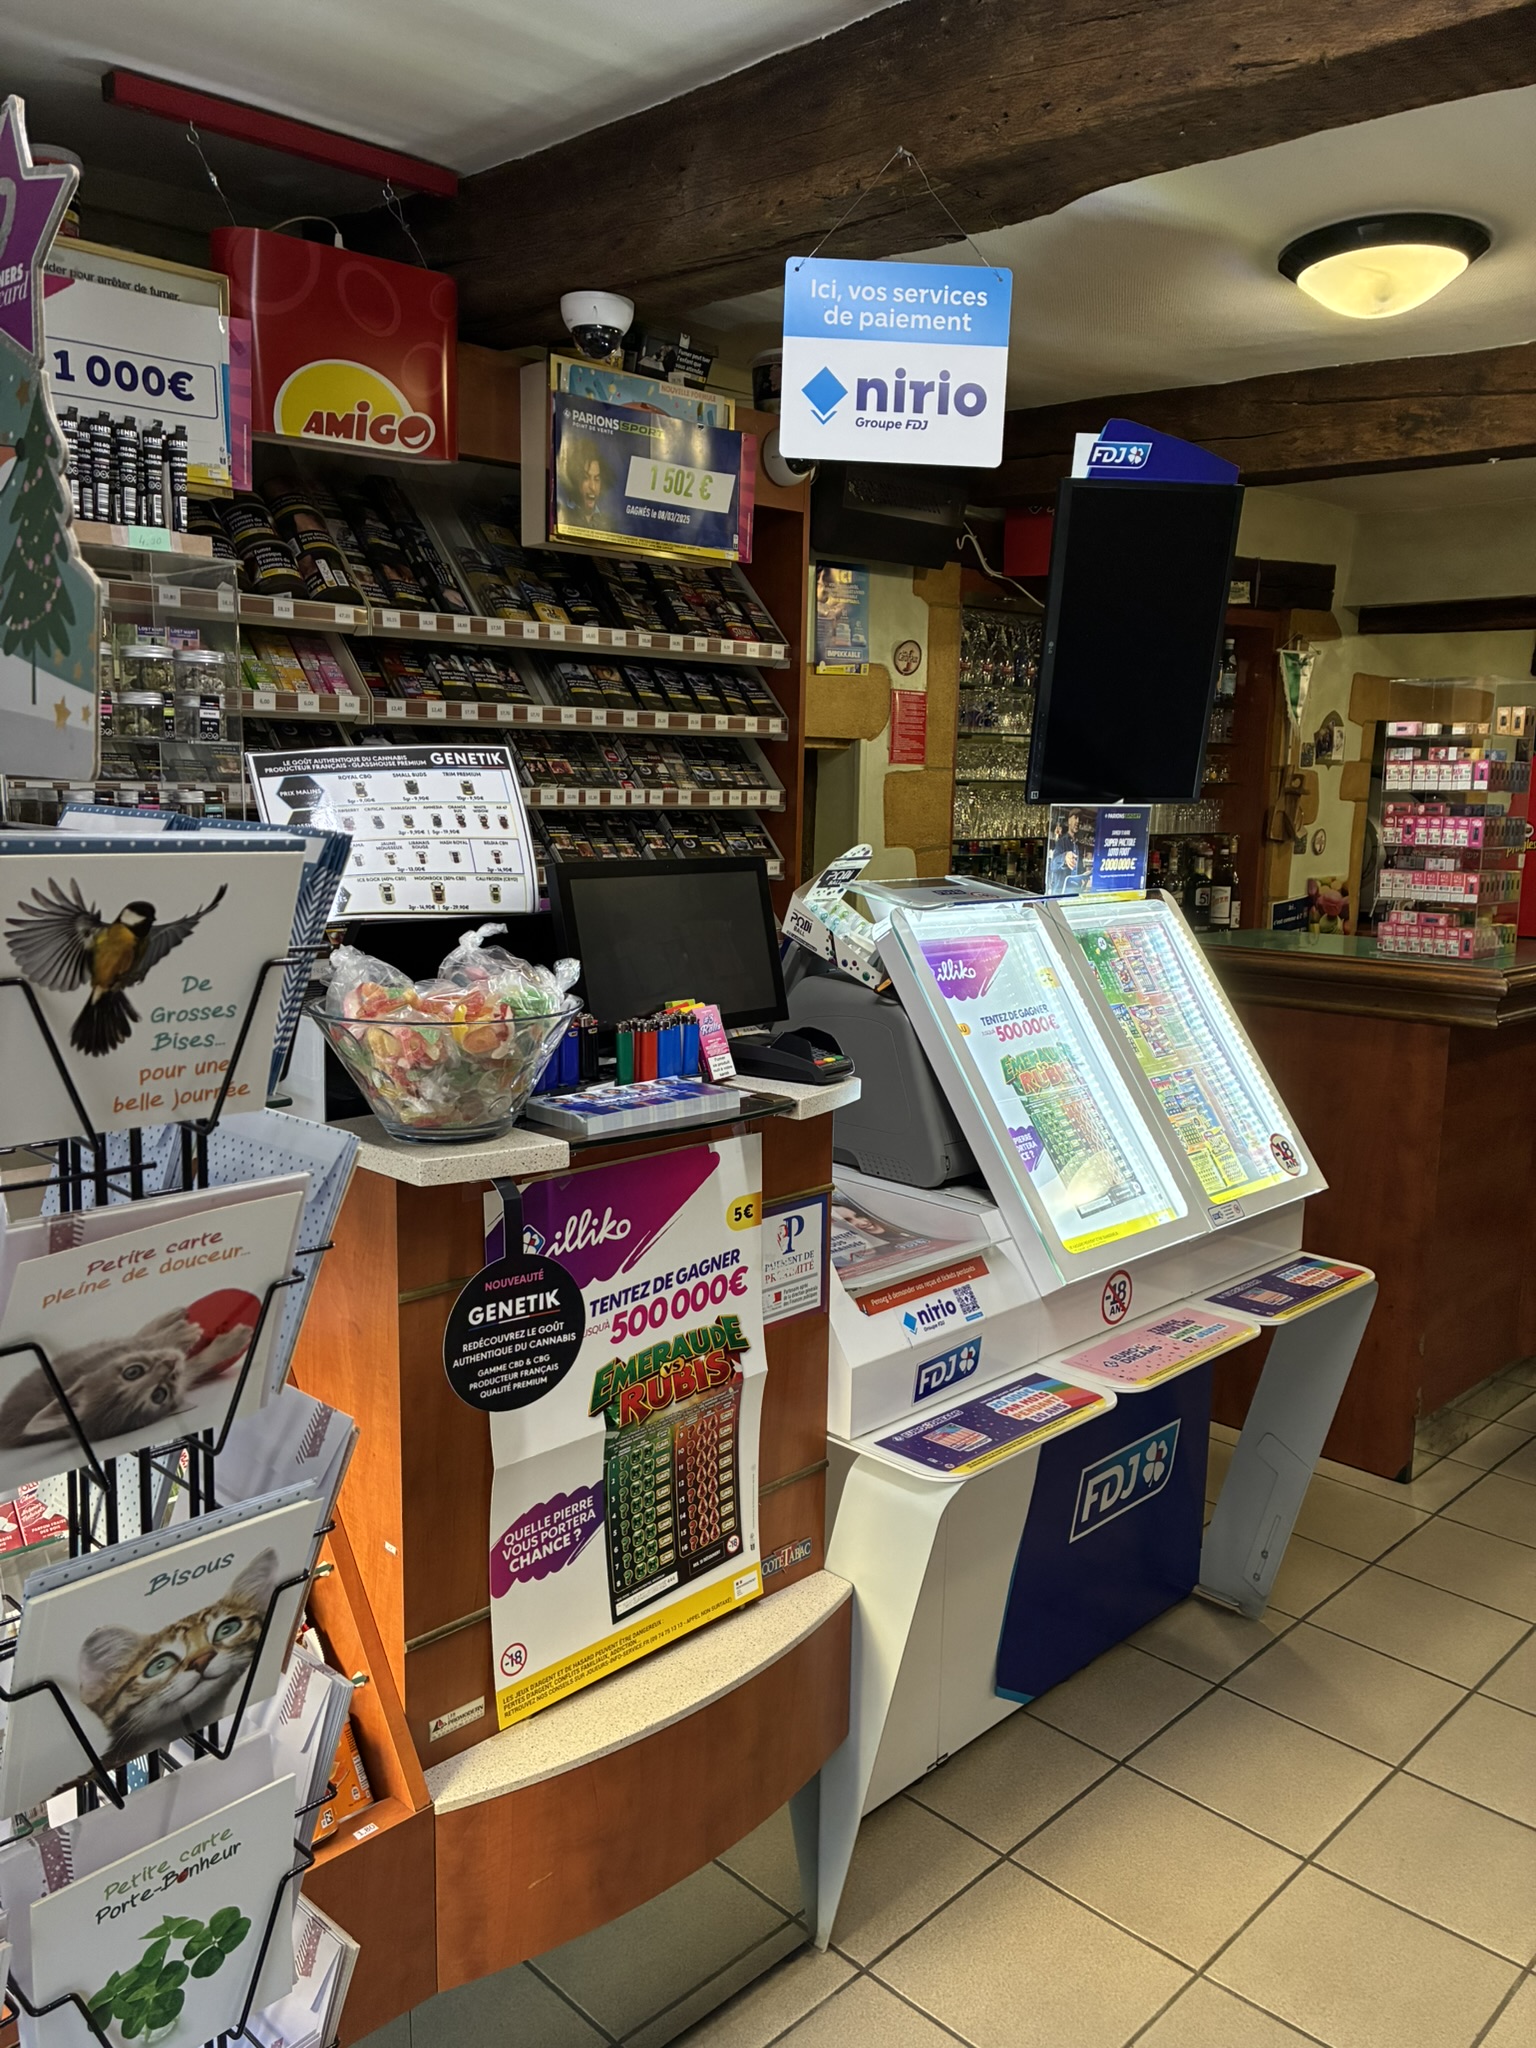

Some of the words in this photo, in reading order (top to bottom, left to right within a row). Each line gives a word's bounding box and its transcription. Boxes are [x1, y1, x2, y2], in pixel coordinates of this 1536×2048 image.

[134, 282, 148, 295] de
[810, 279, 842, 302] Ici,
[848, 285, 888, 302] vos
[893, 285, 988, 307] services
[823, 305, 854, 326] de
[859, 308, 972, 332] paiement
[53, 350, 75, 382] 1
[86, 355, 195, 402] 000€
[856, 367, 988, 418] nirio
[572, 409, 620, 431] PARIONS
[855, 417, 903, 431] Groupe
[905, 419, 929, 431] FDJ
[1091, 445, 1130, 464] FDJ
[650, 466, 657, 491] 1
[663, 468, 694, 499] 502
[699, 474, 713, 501] €
[430, 752, 505, 766] GENETIK
[181, 976, 213, 994] De
[937, 959, 977, 981] illiko
[151, 1003, 237, 1024] Grosses
[980, 1013, 1007, 1027] TENTEZ
[1008, 1011, 1019, 1022] DE
[995, 1021, 1022, 1042] 500
[139, 1064, 187, 1086] pour
[195, 1058, 230, 1076] une
[114, 1092, 165, 1113] belle
[733, 1205, 754, 1222] 5€
[546, 1206, 631, 1258] illiko
[87, 1248, 158, 1276] Petite
[165, 1229, 224, 1254] carte
[42, 1276, 112, 1310] pleine
[121, 1265, 149, 1284] de
[484, 1268, 545, 1292] NOUVEAUTÉ
[589, 1283, 650, 1318] TENTEZ
[652, 1275, 675, 1297] DE
[676, 1249, 741, 1287] GAGNER
[467, 1288, 561, 1326] GENETIK
[609, 1304, 668, 1346] 500
[669, 1265, 749, 1327] 000€
[916, 1298, 957, 1326] nirio
[452, 1344, 513, 1369] AUTHENTIQUE
[515, 1341, 528, 1352] DU
[528, 1331, 577, 1350] CANNABIS
[462, 1328, 525, 1353] REDÉCOUVREZ
[526, 1327, 537, 1337] LE
[538, 1320, 564, 1335] GOÛT
[468, 1371, 519, 1392] PRODUCTEUR
[519, 1362, 560, 1379] FRANÇAIS
[477, 1363, 508, 1378] GAMME
[508, 1359, 525, 1370] CBD
[525, 1358, 532, 1366] &
[532, 1353, 551, 1365] CBG
[588, 1314, 750, 1418] EMERAUDE
[917, 1359, 957, 1396] FDJ
[479, 1382, 512, 1400] QUALITÉ
[512, 1376, 548, 1392] PREMIUM
[618, 1348, 737, 1428] RUBIS
[1080, 1451, 1142, 1524] FDJ
[503, 1534, 539, 1562] VOUS
[541, 1508, 597, 1546] PORTERA
[504, 1516, 551, 1547] QUELLE
[553, 1495, 595, 1527] PIERRE
[509, 1536, 571, 1574] CHANCE
[574, 1528, 582, 1546] ?
[144, 1551, 235, 1597] Bisous
[103, 1862, 171, 1901] Petite
[179, 1826, 234, 1863] carte
